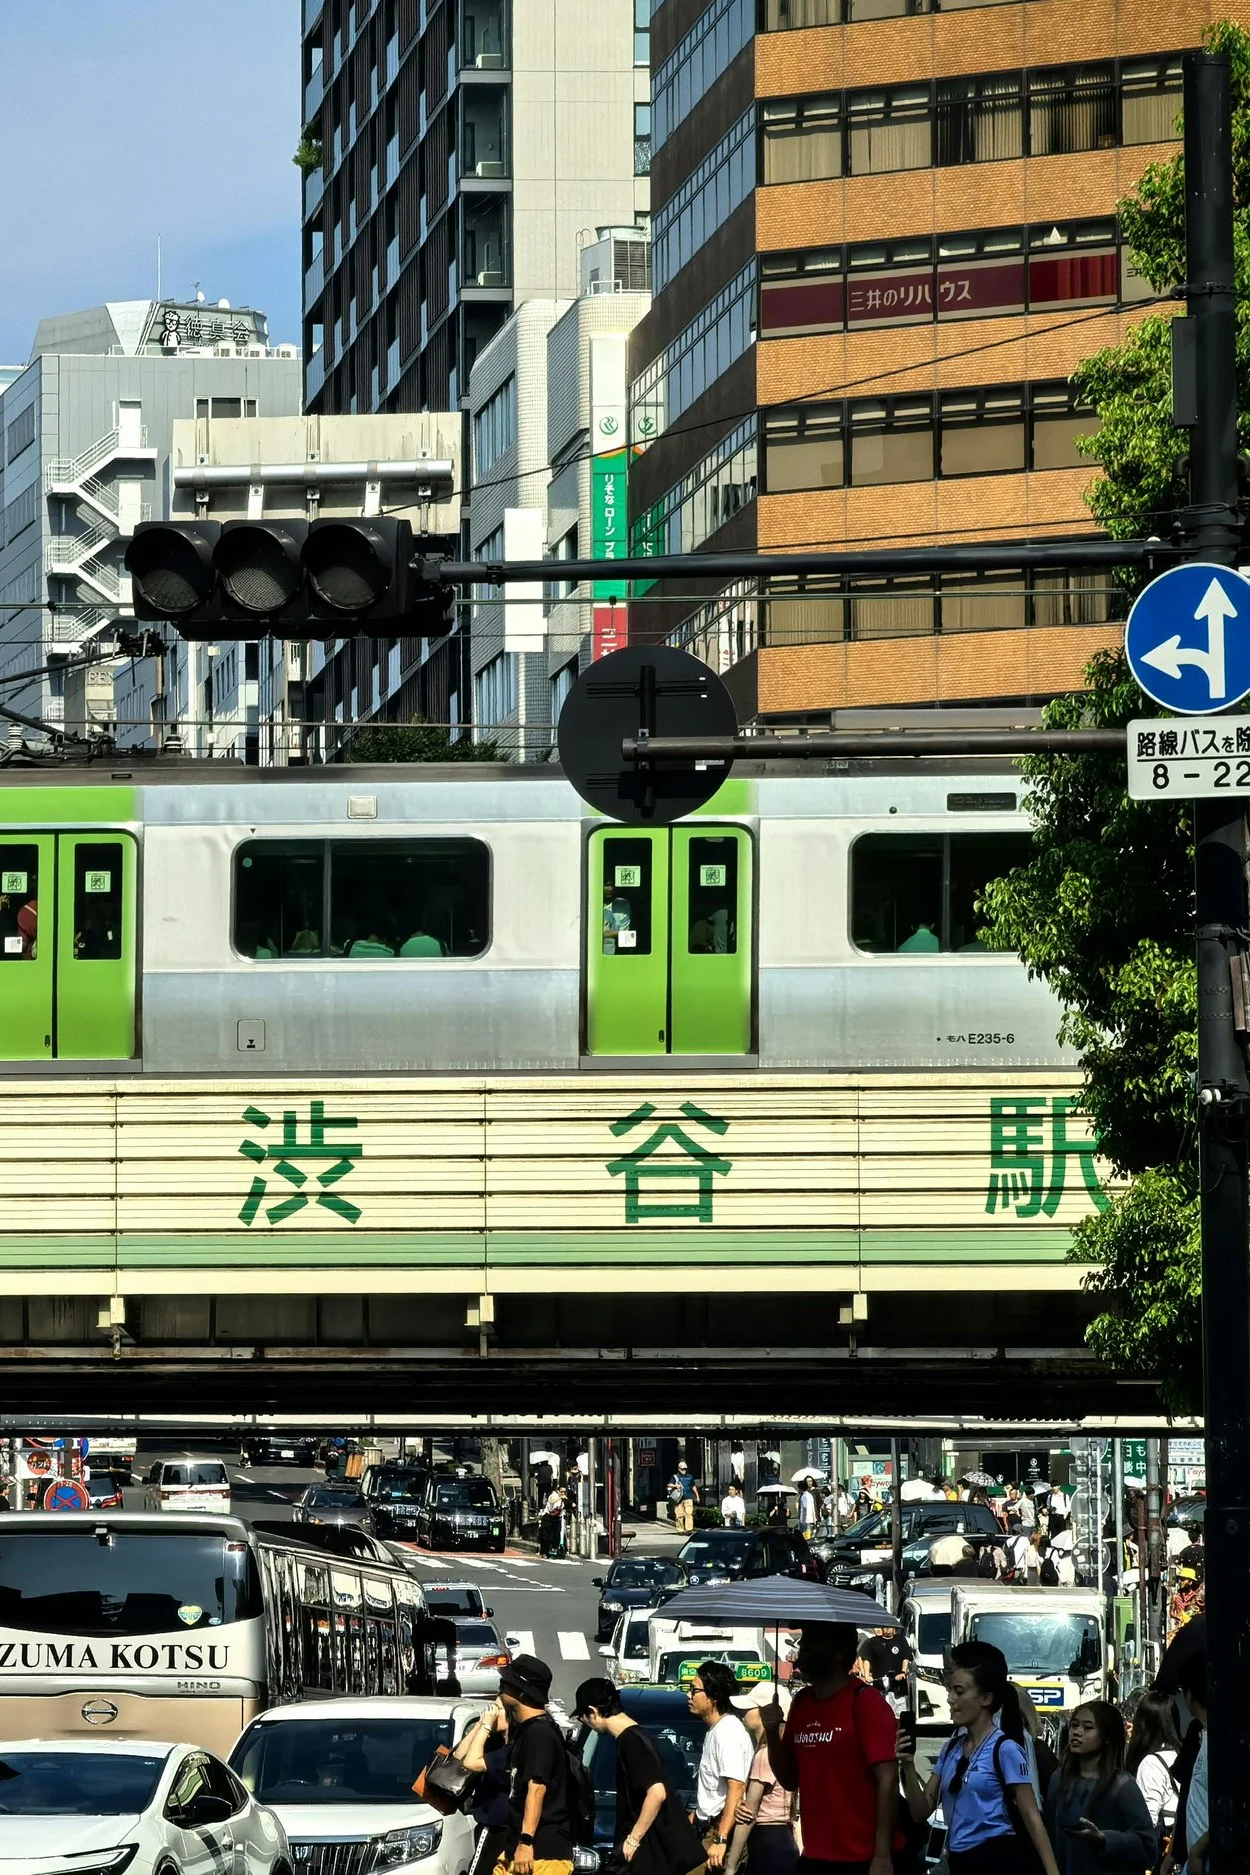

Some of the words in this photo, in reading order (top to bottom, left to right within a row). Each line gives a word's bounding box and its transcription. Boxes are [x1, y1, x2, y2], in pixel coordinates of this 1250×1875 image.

[850, 280, 972, 311] 三井のリハウス
[109, 1644, 230, 1670] KOTSU
[741, 1667, 767, 1678] 8609
[177, 1681, 221, 1690] HINO
